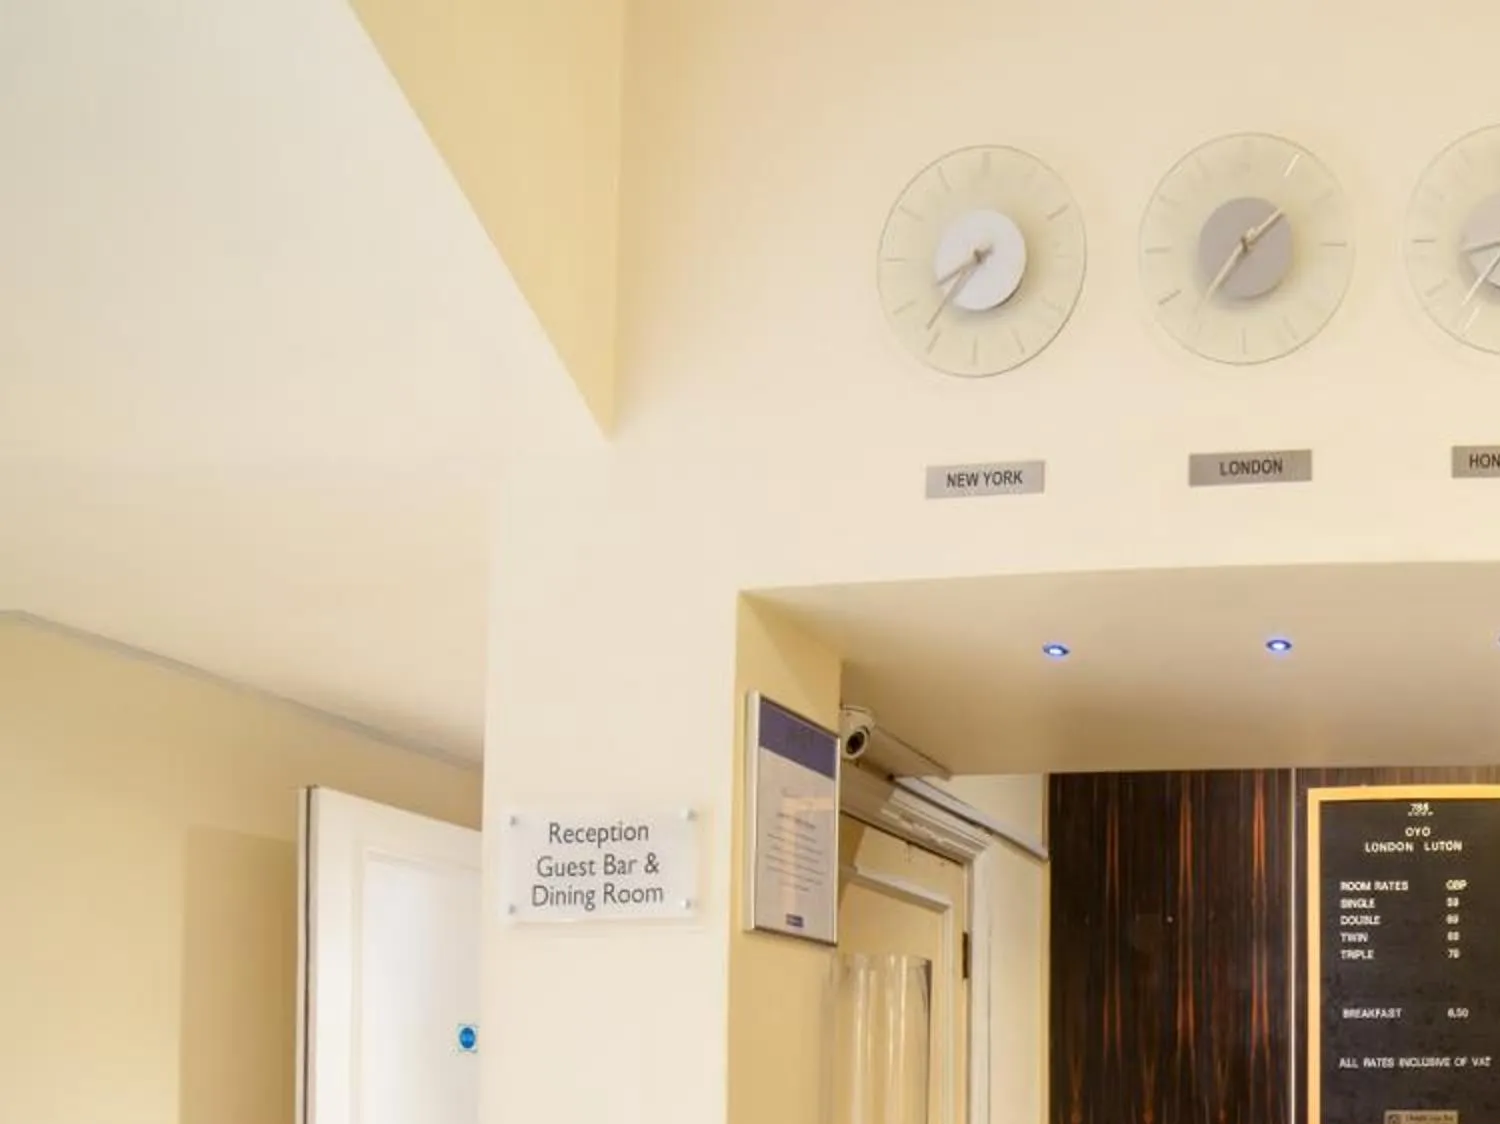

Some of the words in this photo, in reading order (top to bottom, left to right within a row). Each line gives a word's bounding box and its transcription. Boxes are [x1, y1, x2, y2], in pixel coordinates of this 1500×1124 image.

[1219, 458, 1284, 477] LONDON
[946, 473, 979, 489] NEW
[982, 470, 1024, 487] YORK
[548, 821, 650, 848] Reception
[1404, 826, 1432, 837] OYO
[1364, 841, 1415, 853] LONDON
[1423, 840, 1463, 852] LUTON
[536, 856, 596, 878] Guest
[603, 854, 637, 876] Bar
[644, 852, 660, 875] &
[1339, 881, 1372, 891] ROOM
[1373, 880, 1409, 891] RATES
[531, 885, 596, 911] Dining
[602, 883, 664, 905] Room
[1339, 898, 1376, 909] SINGLE
[1339, 915, 1381, 926] DOUBLE
[1339, 932, 1369, 943] TWIN
[1339, 949, 1375, 960] TRIPLE
[1342, 1008, 1402, 1019] BREAKFAST
[1339, 1057, 1359, 1069] ALL
[1363, 1056, 1395, 1068] RATES
[1399, 1056, 1451, 1068] INCLUSIVE
[1454, 1056, 1467, 1067] OF
